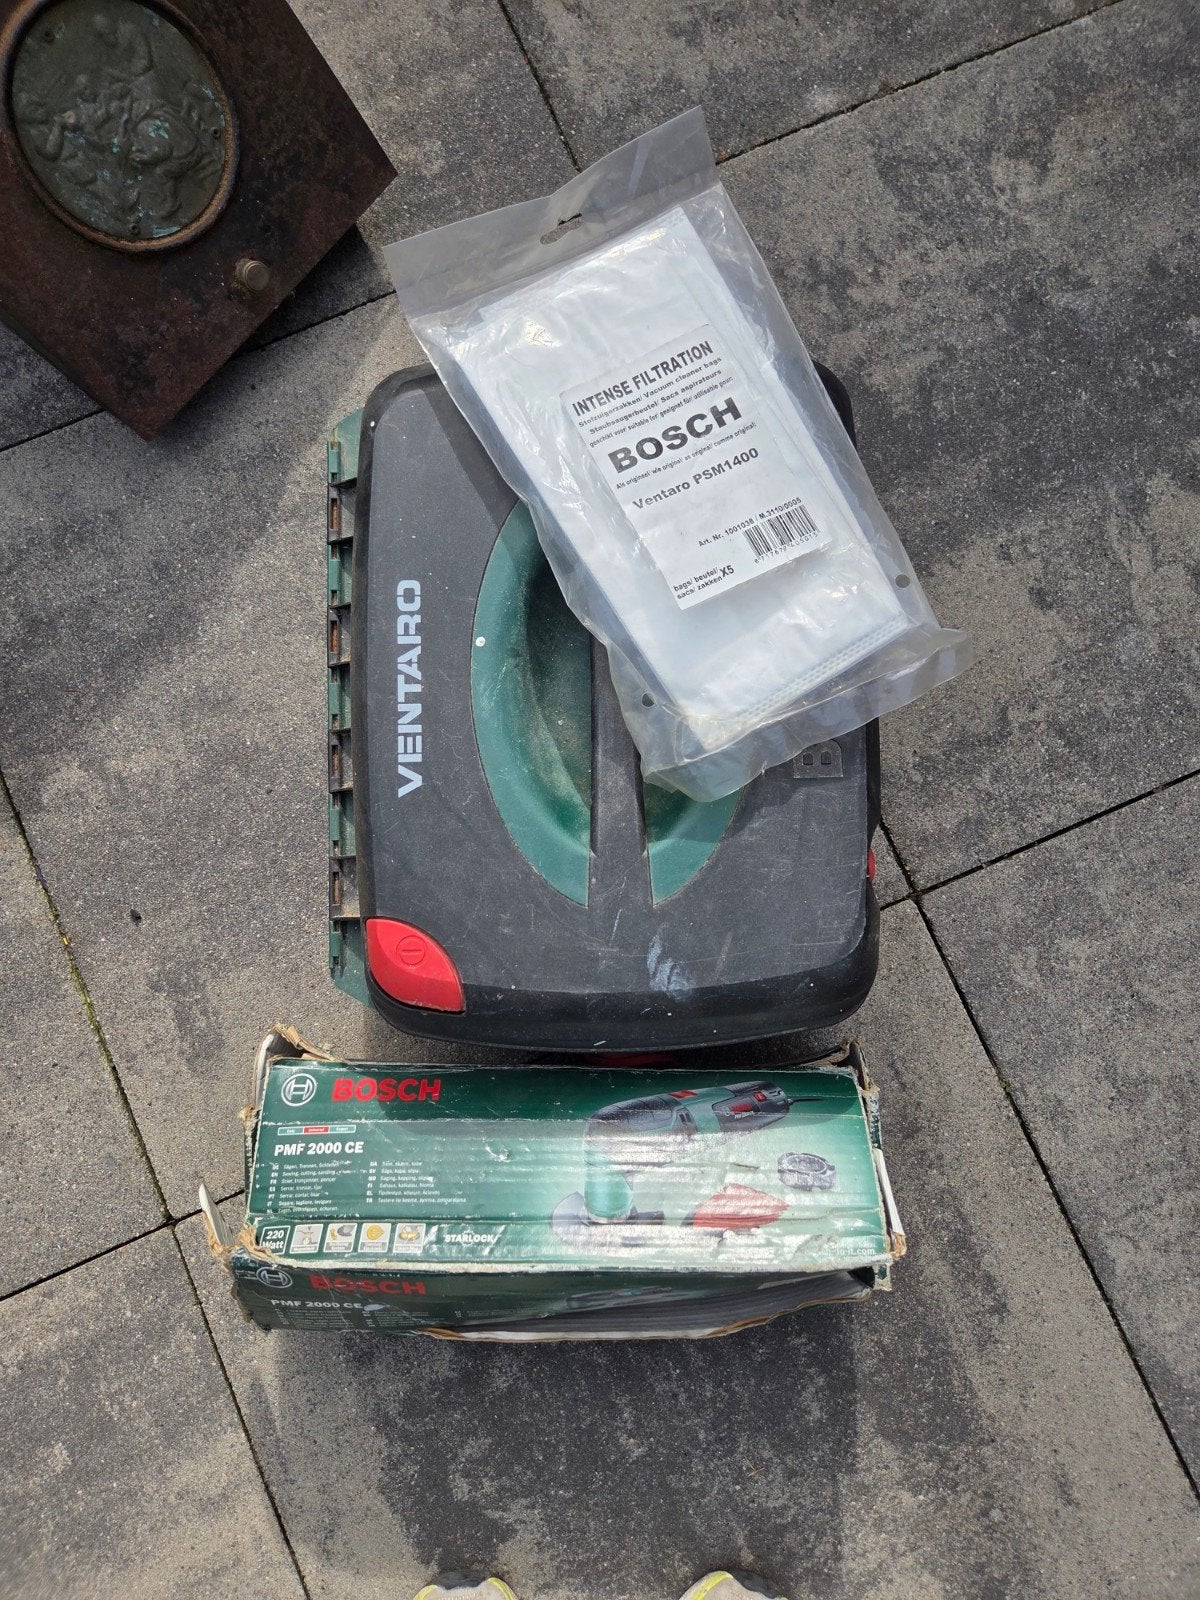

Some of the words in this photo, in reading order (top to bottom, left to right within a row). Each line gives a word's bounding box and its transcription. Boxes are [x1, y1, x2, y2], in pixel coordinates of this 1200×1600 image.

[572, 380, 633, 416] INTENSE
[632, 340, 713, 389] FILTRATION
[643, 381, 674, 398] Vacuum
[675, 366, 702, 382] cleaner
[702, 357, 722, 368] bags
[660, 390, 679, 403] Sacs
[680, 369, 721, 393] aspirateurs
[608, 397, 741, 472] BOSCH
[632, 481, 690, 508] Ventaro
[692, 447, 758, 484] PSM1400
[698, 538, 712, 546] Art.
[711, 533, 724, 541] Nr.
[724, 517, 754, 535] 1001038
[719, 564, 734, 577] X5
[697, 575, 722, 590] zakken
[397, 580, 422, 798] VENTARO
[331, 1077, 442, 1103] BOSCH
[274, 1143, 305, 1157] PMF
[307, 1142, 342, 1155] 2000
[344, 1141, 364, 1154] CE
[263, 1239, 284, 1250] Watt
[266, 1230, 285, 1240] 220
[445, 1233, 495, 1244] STARLOCK
[309, 1275, 426, 1295] BOSCH
[271, 1300, 301, 1310] PMF
[306, 1301, 340, 1310] 2000
[342, 1303, 363, 1311] CE
